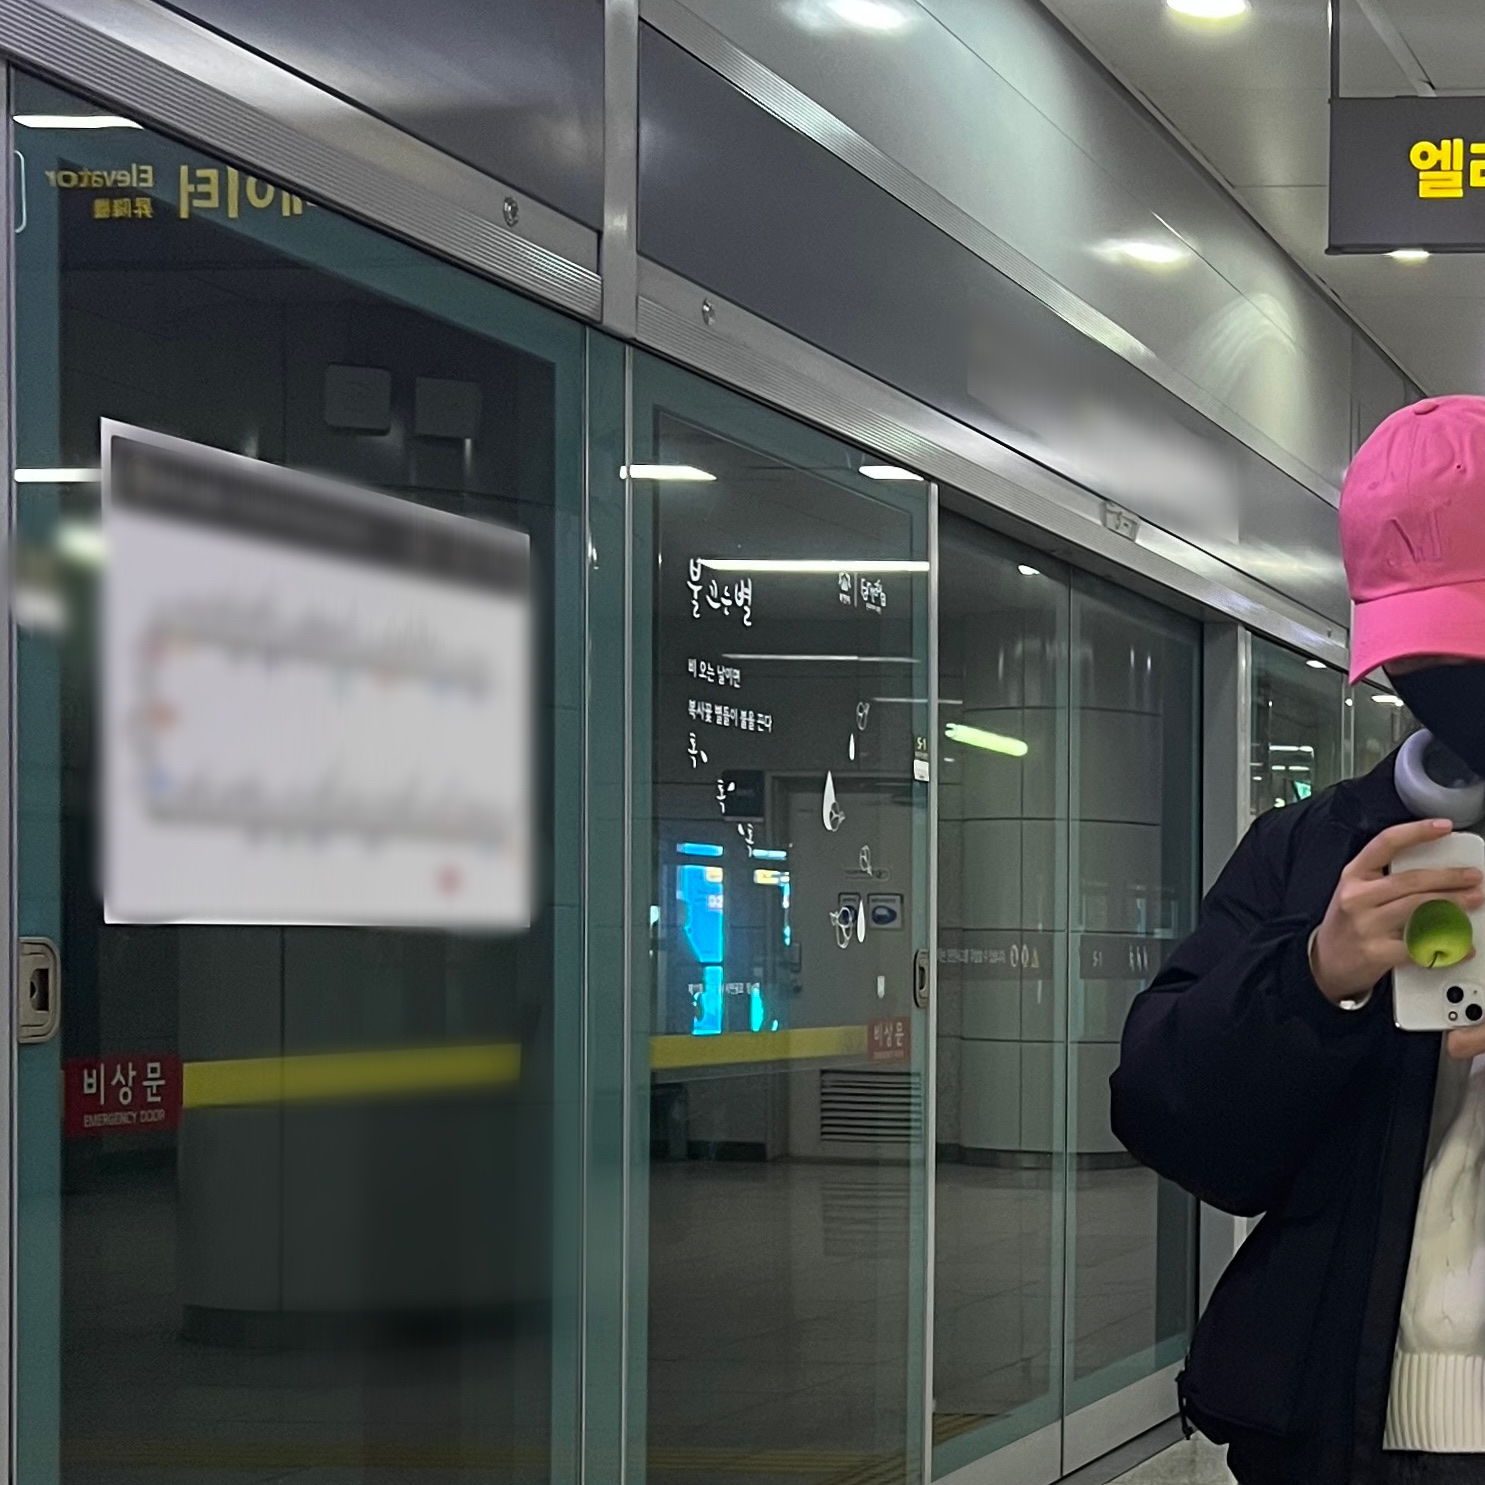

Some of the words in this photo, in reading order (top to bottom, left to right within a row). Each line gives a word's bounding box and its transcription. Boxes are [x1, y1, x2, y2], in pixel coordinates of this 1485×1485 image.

[698, 660, 715, 683] 오는
[717, 664, 741, 688] 날이면
[873, 1021, 905, 1048] 비상문
[83, 1062, 166, 1106] 비상문
